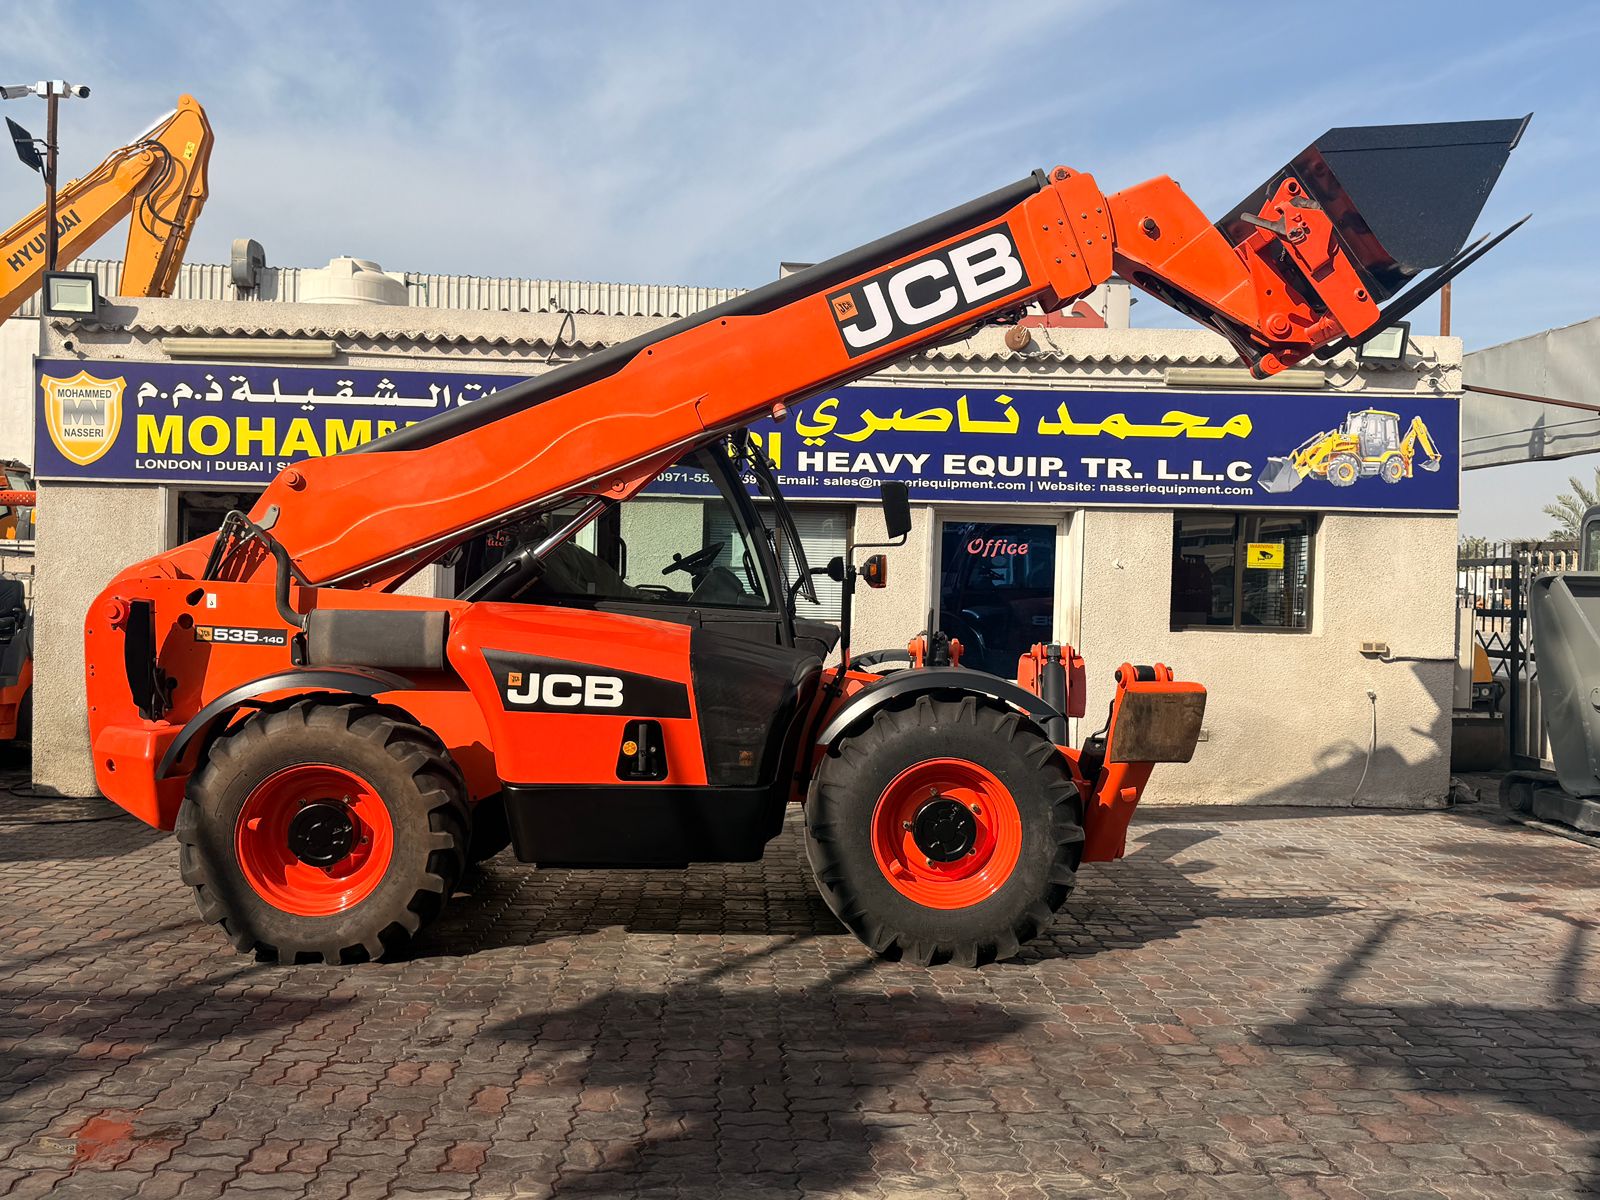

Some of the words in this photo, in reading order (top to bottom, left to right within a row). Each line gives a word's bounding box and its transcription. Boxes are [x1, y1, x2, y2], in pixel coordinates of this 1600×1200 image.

[842, 233, 1023, 348] JCB
[57, 388, 112, 399] MOHAMMED
[795, 393, 1020, 447] ناصري
[1037, 401, 1253, 440] محمد
[64, 428, 104, 438] NASSERI
[135, 459, 202, 470] LONDON
[215, 461, 264, 471] DUBAI
[797, 451, 931, 474] HEAVY
[943, 454, 1068, 478] EQUIP.
[1080, 457, 1143, 479] TR.
[1157, 459, 1253, 482] L.L.C
[777, 475, 819, 486] Email:
[1037, 481, 1096, 492] Website:
[1100, 483, 1254, 496] nasseriequipment.com
[966, 538, 1029, 558] Office
[213, 628, 285, 644] 535-140
[507, 673, 624, 708] JCB
